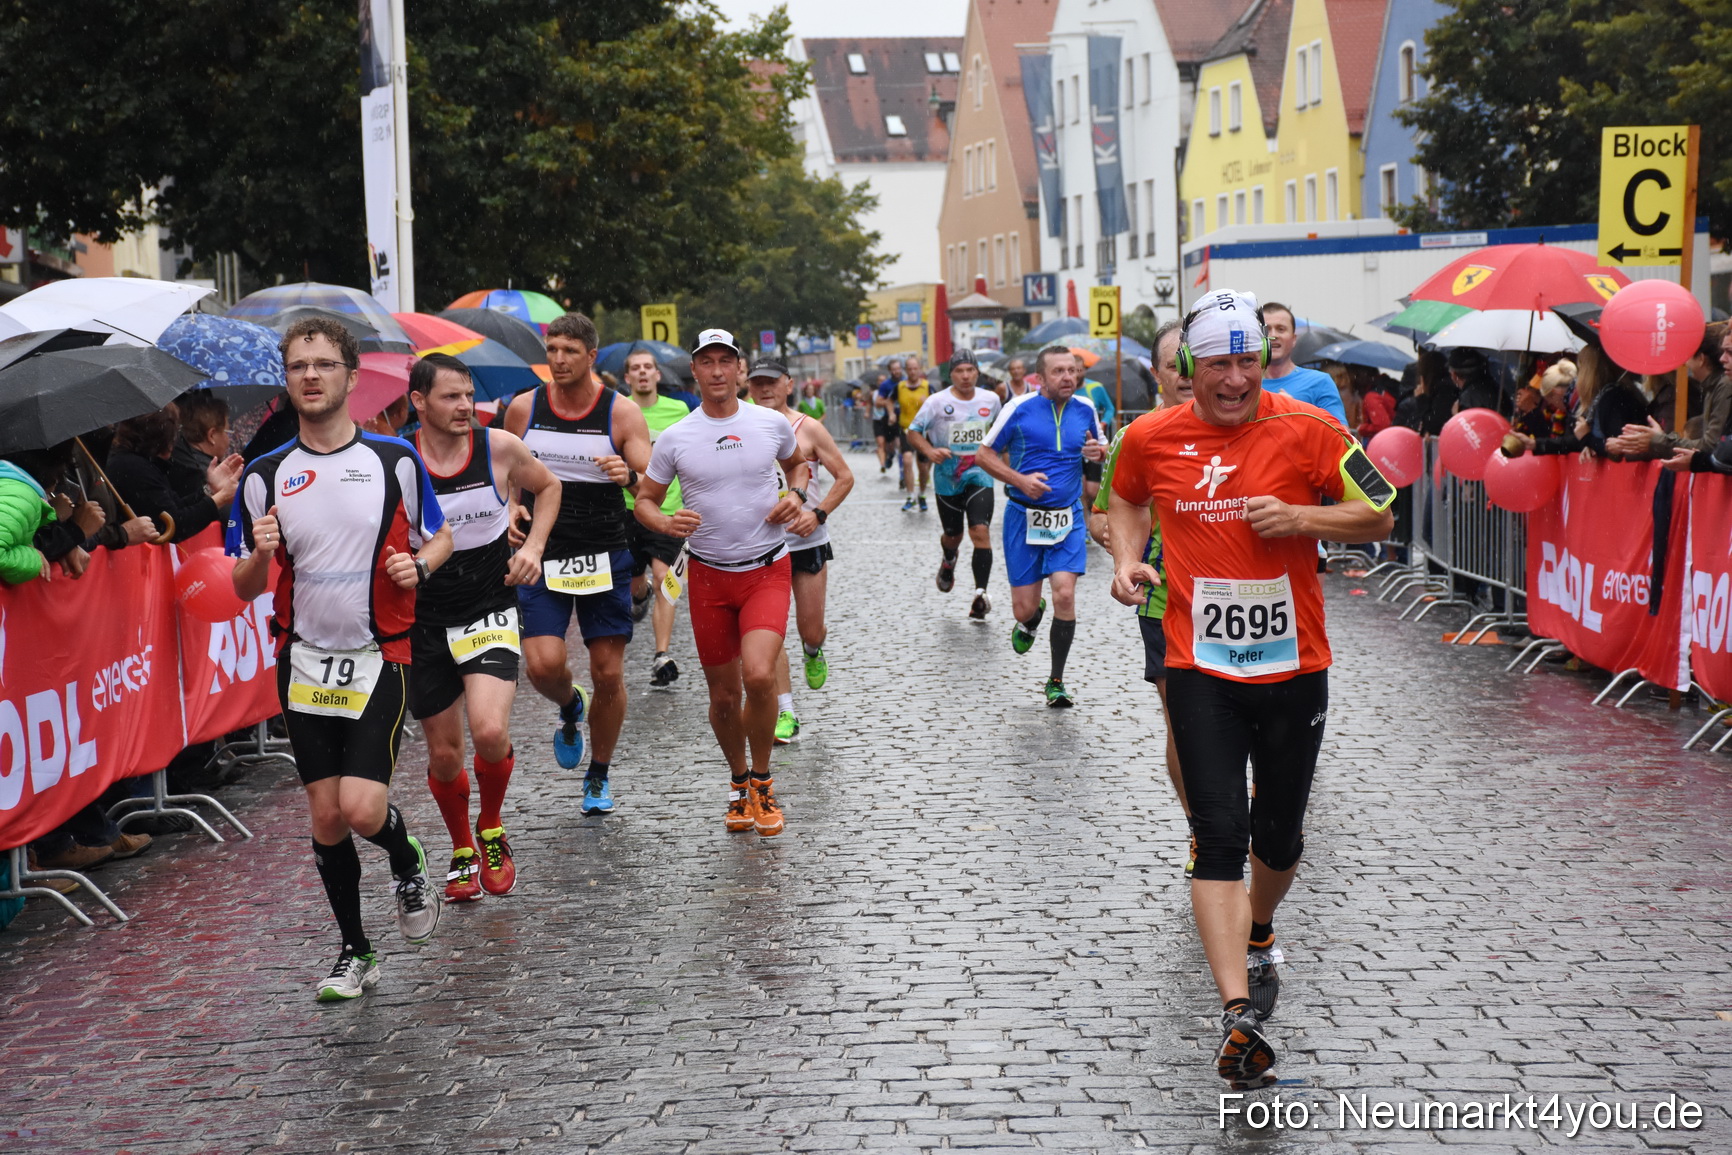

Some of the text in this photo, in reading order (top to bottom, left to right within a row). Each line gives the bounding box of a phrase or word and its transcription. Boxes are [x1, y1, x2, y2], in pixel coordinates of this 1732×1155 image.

[1614, 132, 1687, 157] Block
[1623, 168, 1672, 236] C
[1093, 288, 1117, 298] Block
[645, 306, 671, 317] Block
[1098, 302, 1113, 326] D
[652, 321, 668, 342] D
[953, 429, 983, 443] 2398
[716, 442, 743, 451] skinfit
[283, 475, 305, 490] tkn
[1176, 496, 1249, 514] funrunners
[475, 511, 492, 519] LELL
[1032, 511, 1068, 529] 2610
[558, 555, 597, 575] 259
[562, 580, 595, 588] Maurice
[1238, 580, 1287, 595] BOCK
[1203, 600, 1288, 640] 2695
[472, 633, 503, 648] Flocke
[1229, 650, 1264, 663] Peter
[320, 656, 355, 687] 19
[312, 691, 348, 705] Stefan
